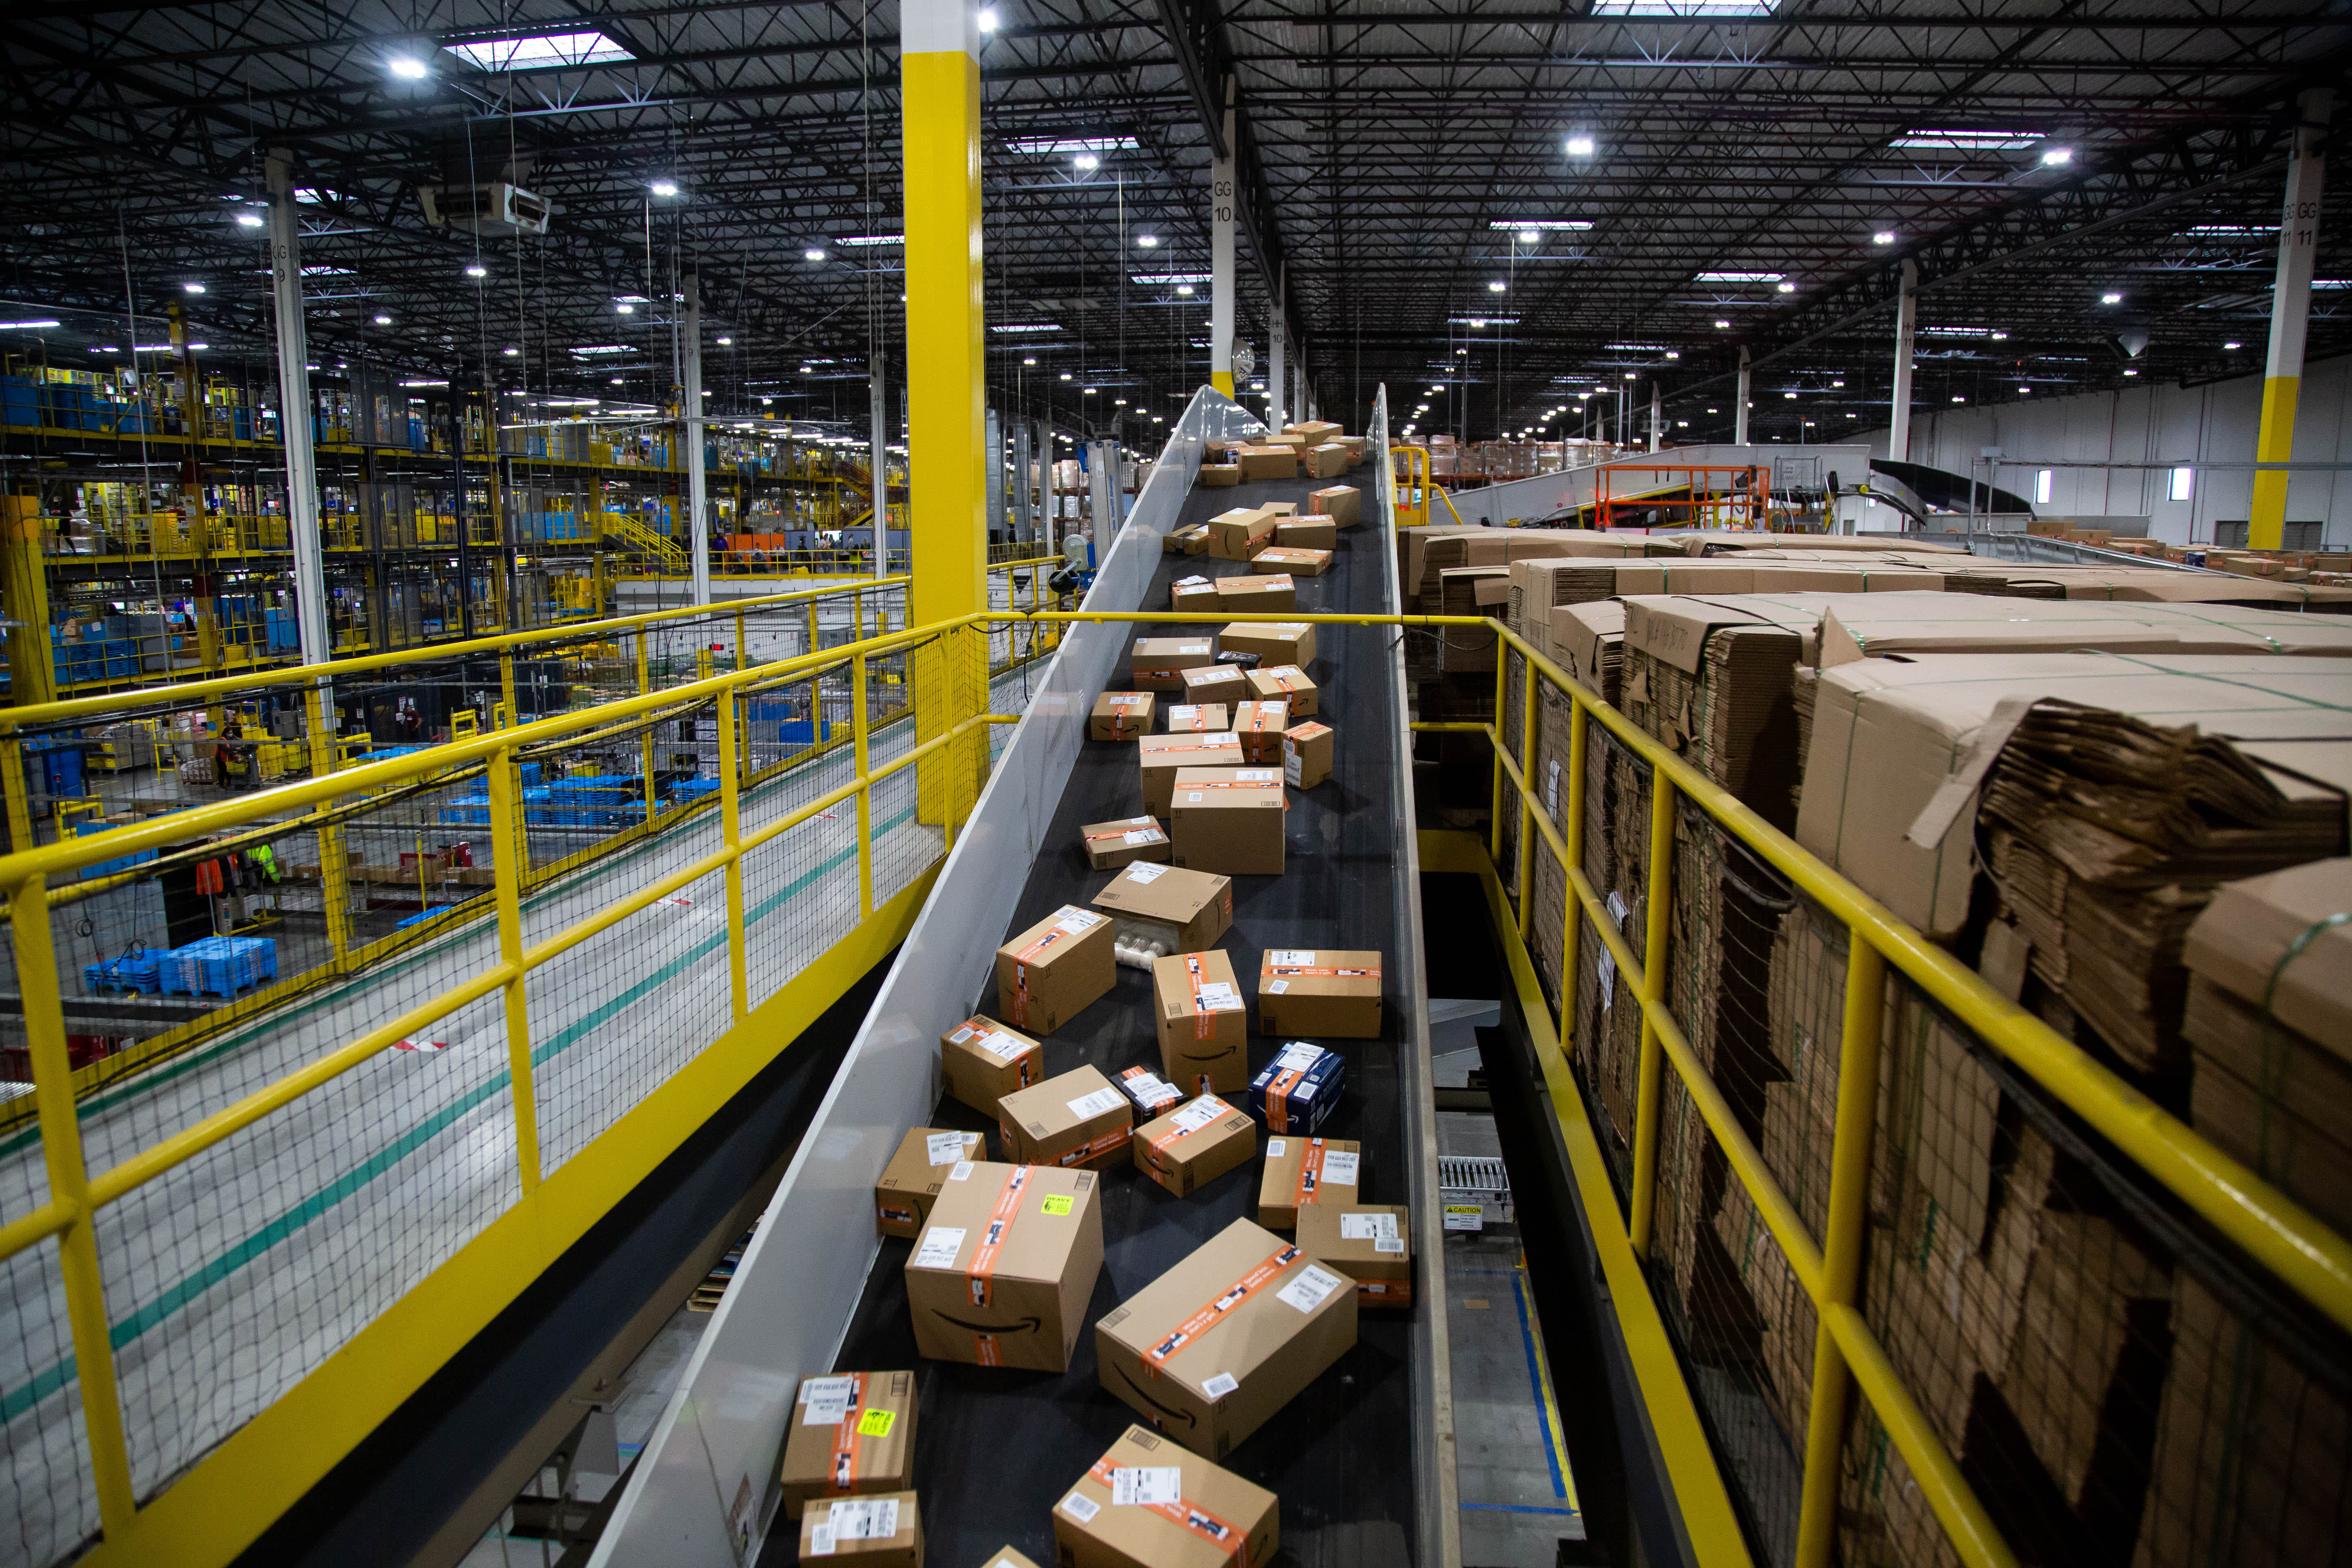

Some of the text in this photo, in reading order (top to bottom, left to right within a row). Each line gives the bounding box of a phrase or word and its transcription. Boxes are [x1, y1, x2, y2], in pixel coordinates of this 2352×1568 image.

[1214, 181, 1231, 196] GG
[1215, 207, 1231, 221] 10
[2297, 203, 2316, 218] GG
[2298, 230, 2312, 245] 11
[1272, 319, 1283, 328] HH
[1272, 334, 1282, 343] 10
[1904, 338, 1912, 346] 11
[1183, 1311, 1207, 1332] Wow, now
